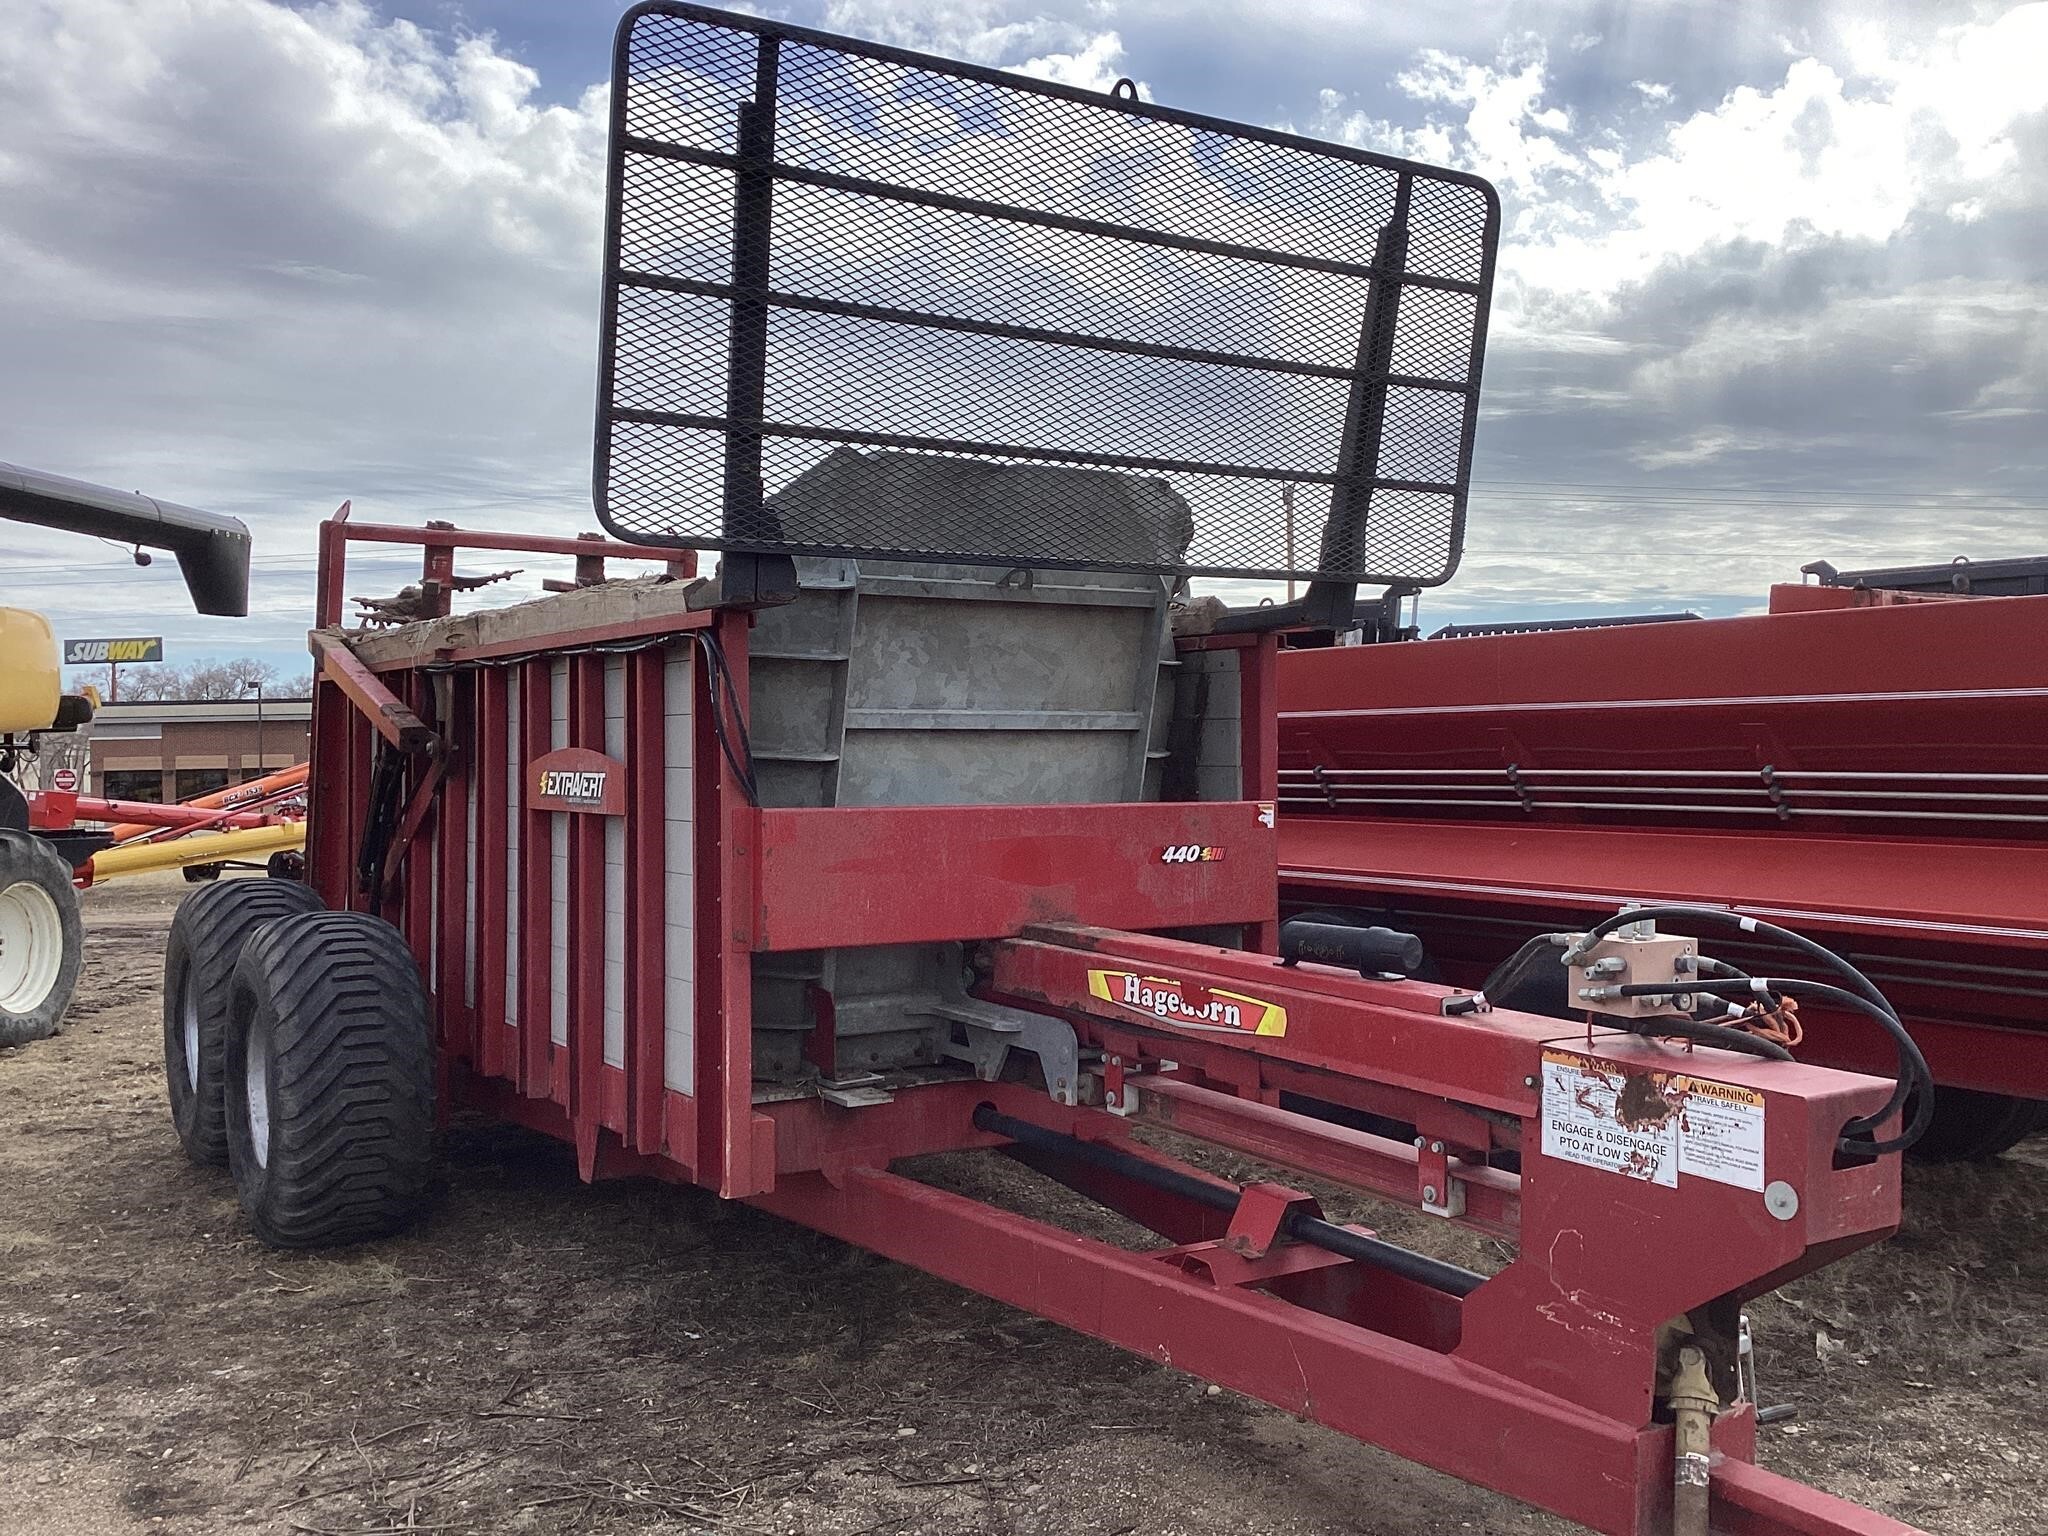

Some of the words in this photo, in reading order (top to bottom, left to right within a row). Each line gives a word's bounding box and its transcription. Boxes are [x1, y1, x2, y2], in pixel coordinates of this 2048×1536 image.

[67, 640, 156, 662] SUBWAY
[1161, 845, 1201, 863] 440
[1700, 1083, 1754, 1103] WARNING
[1693, 1095, 1719, 1107] TRAVEL
[1721, 1101, 1748, 1112] SAFELY
[1552, 1120, 1594, 1138] ENGAGE
[1596, 1130, 1603, 1140] &
[1606, 1133, 1667, 1156] DISENGAGE
[1560, 1136, 1580, 1149] PTO
[1582, 1142, 1595, 1153] AT
[1597, 1147, 1621, 1160] LOW
[1565, 1151, 1580, 1160] READ
